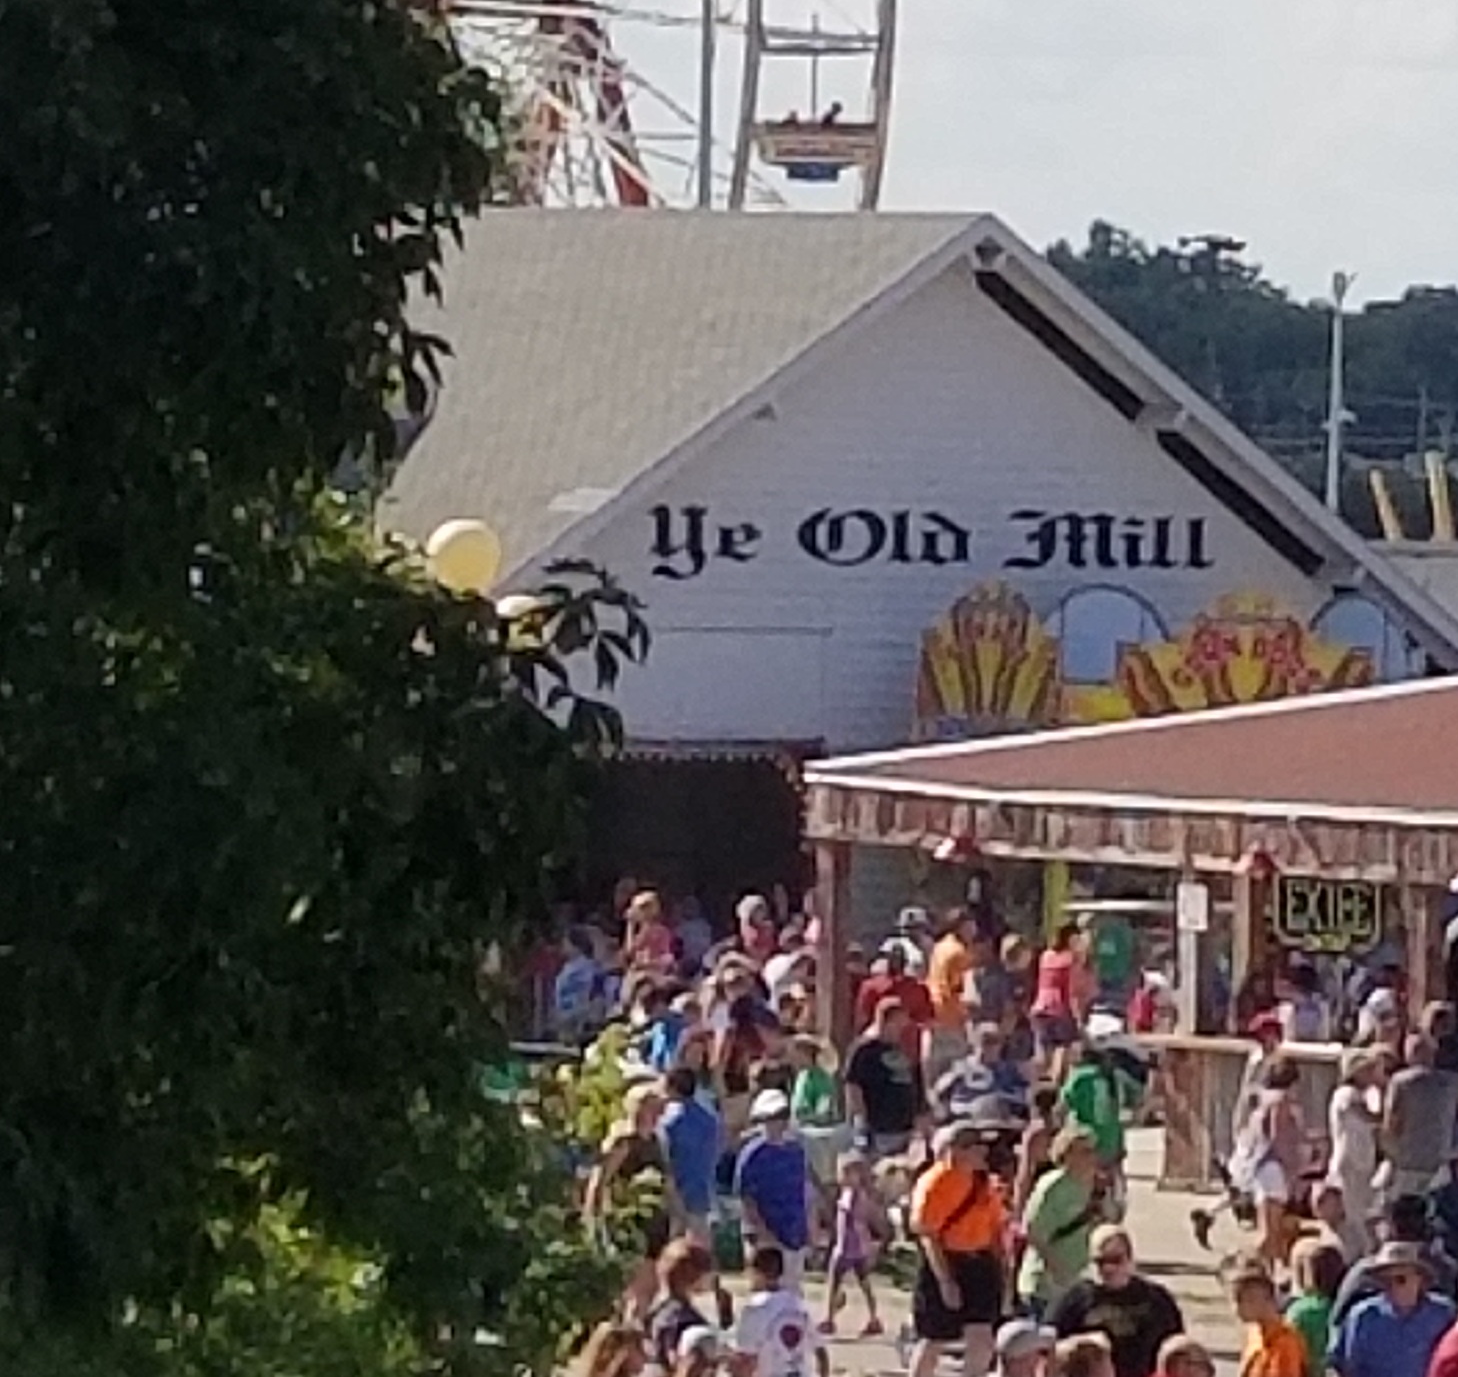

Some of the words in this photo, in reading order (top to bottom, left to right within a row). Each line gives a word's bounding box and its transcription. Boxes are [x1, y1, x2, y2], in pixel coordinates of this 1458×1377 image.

[649, 505, 761, 580] Ye
[797, 507, 971, 567] Old
[1004, 509, 1214, 570] Mill
